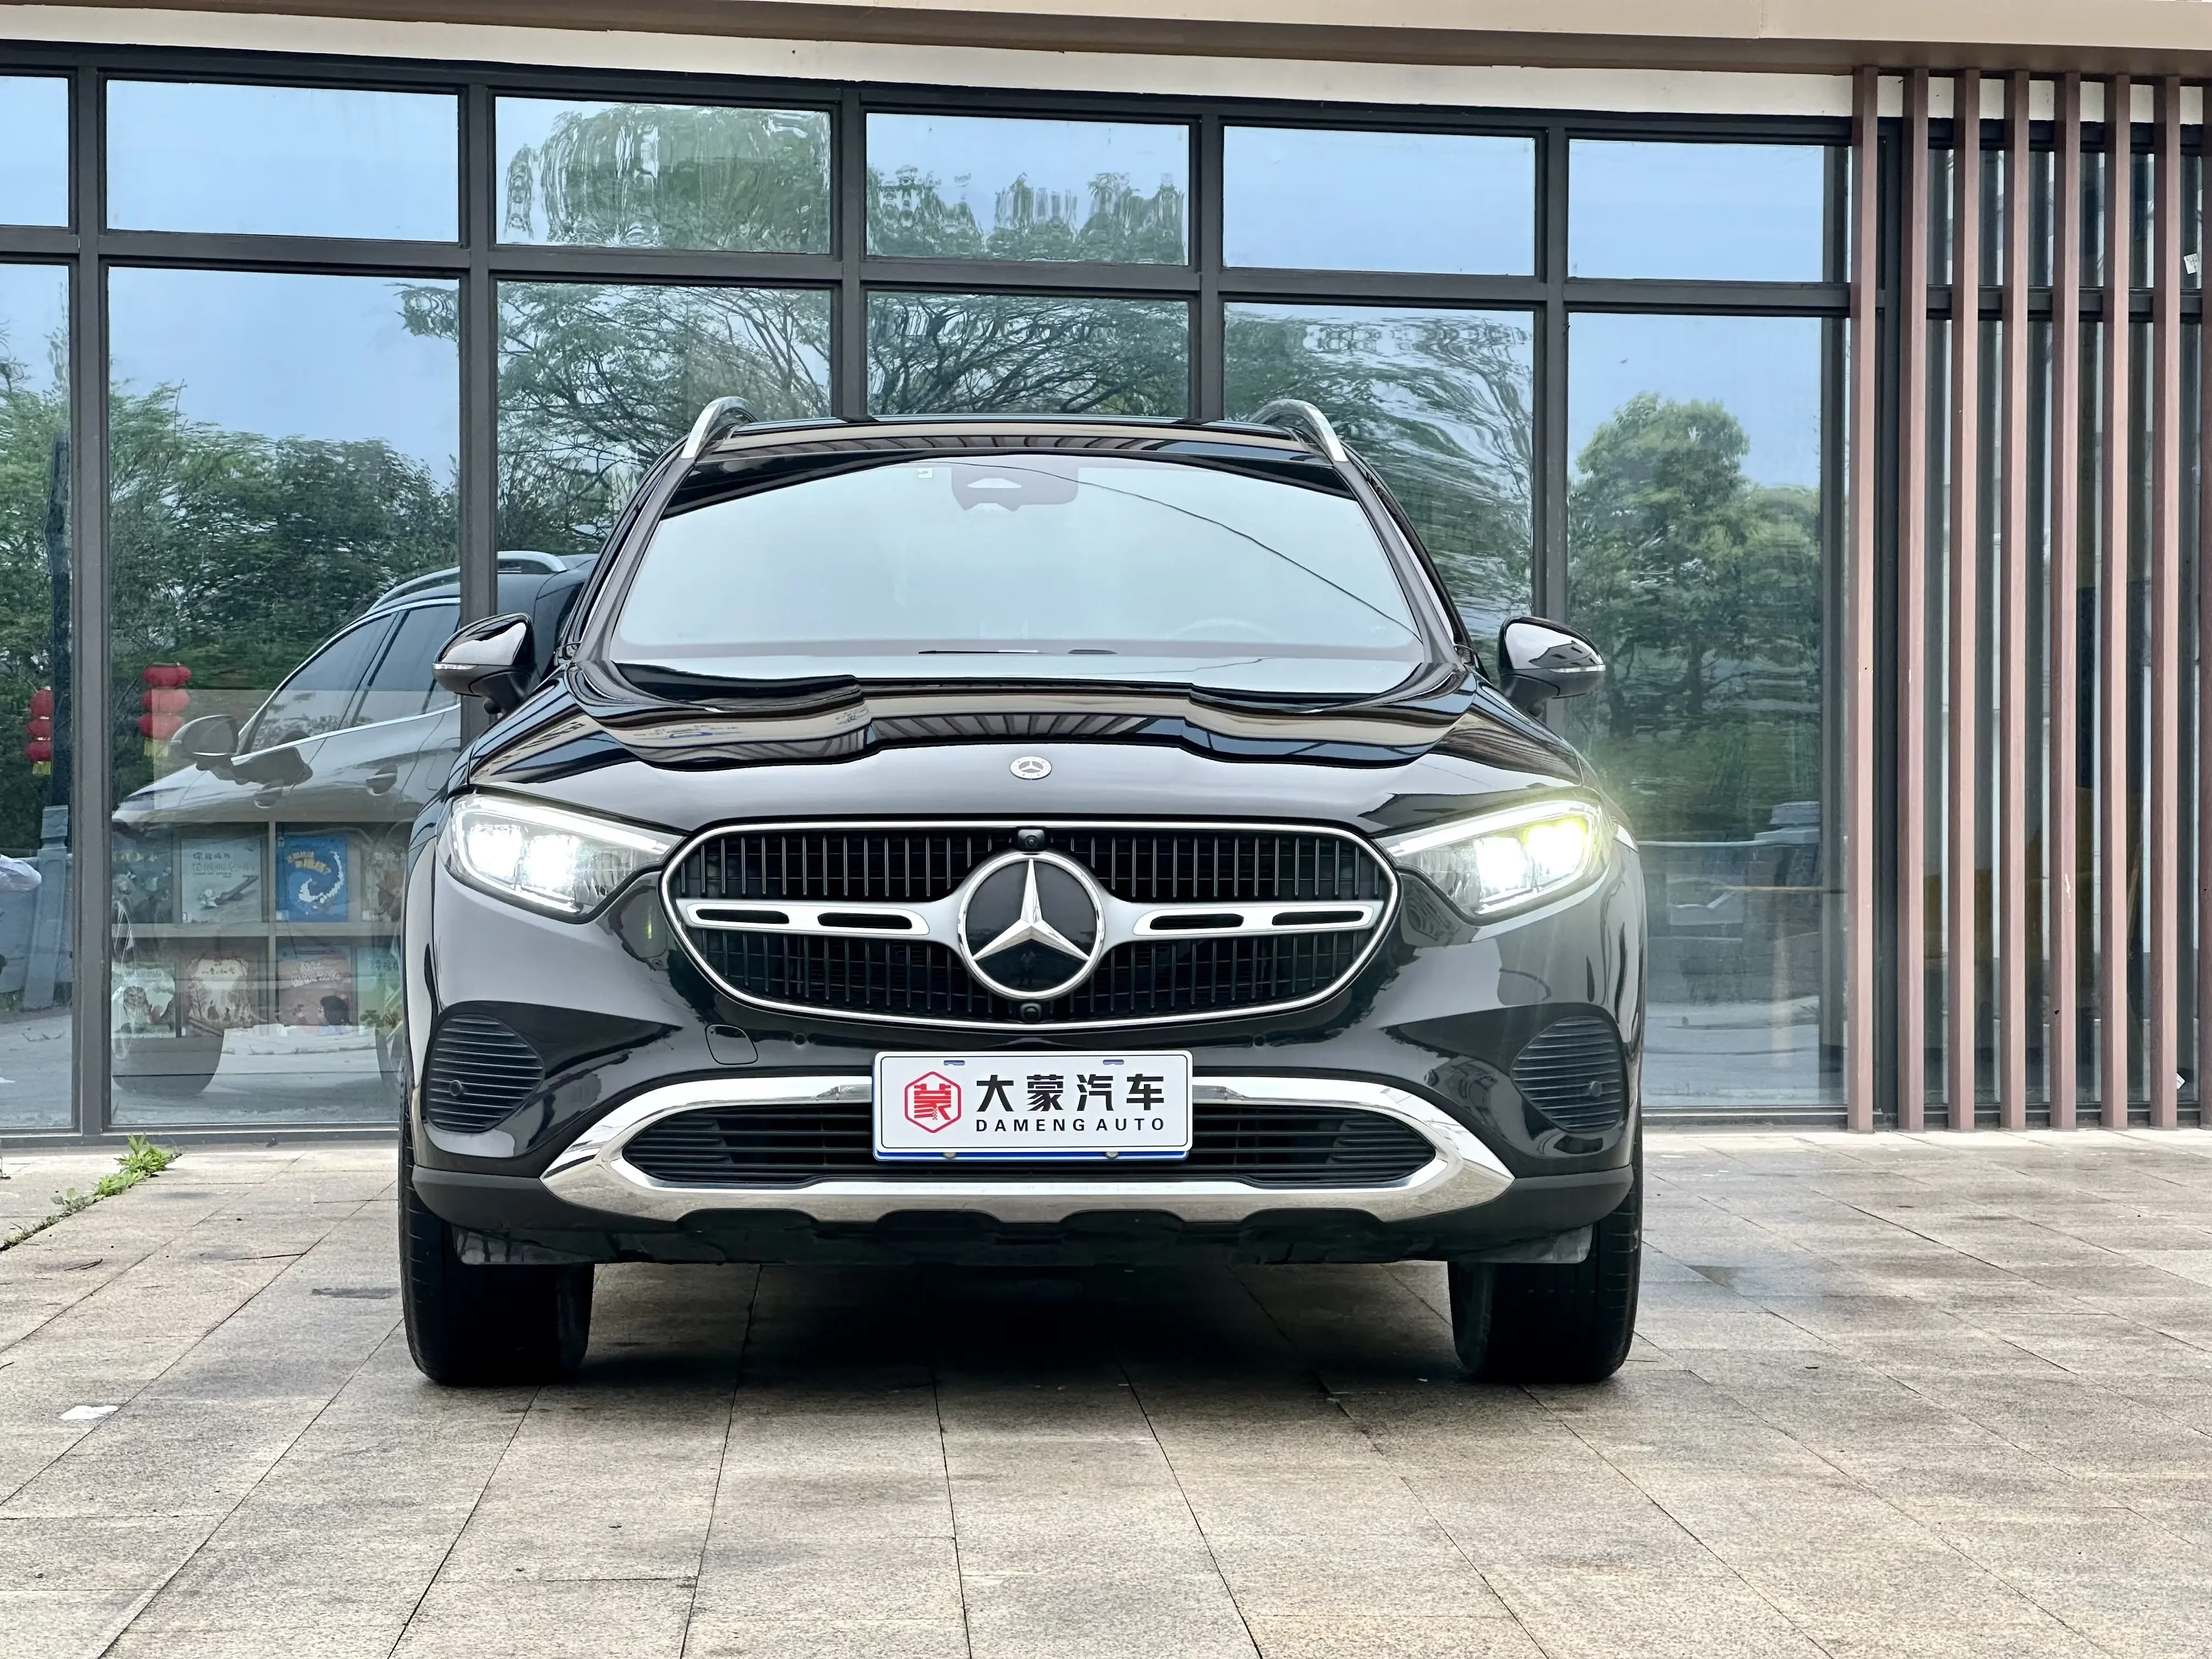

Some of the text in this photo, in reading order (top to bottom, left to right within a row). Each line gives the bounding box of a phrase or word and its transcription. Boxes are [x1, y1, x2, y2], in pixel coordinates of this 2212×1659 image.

[976, 1073, 1164, 1112] 大蒙汽车
[976, 1118, 1164, 1132] DAMENG AUTO
